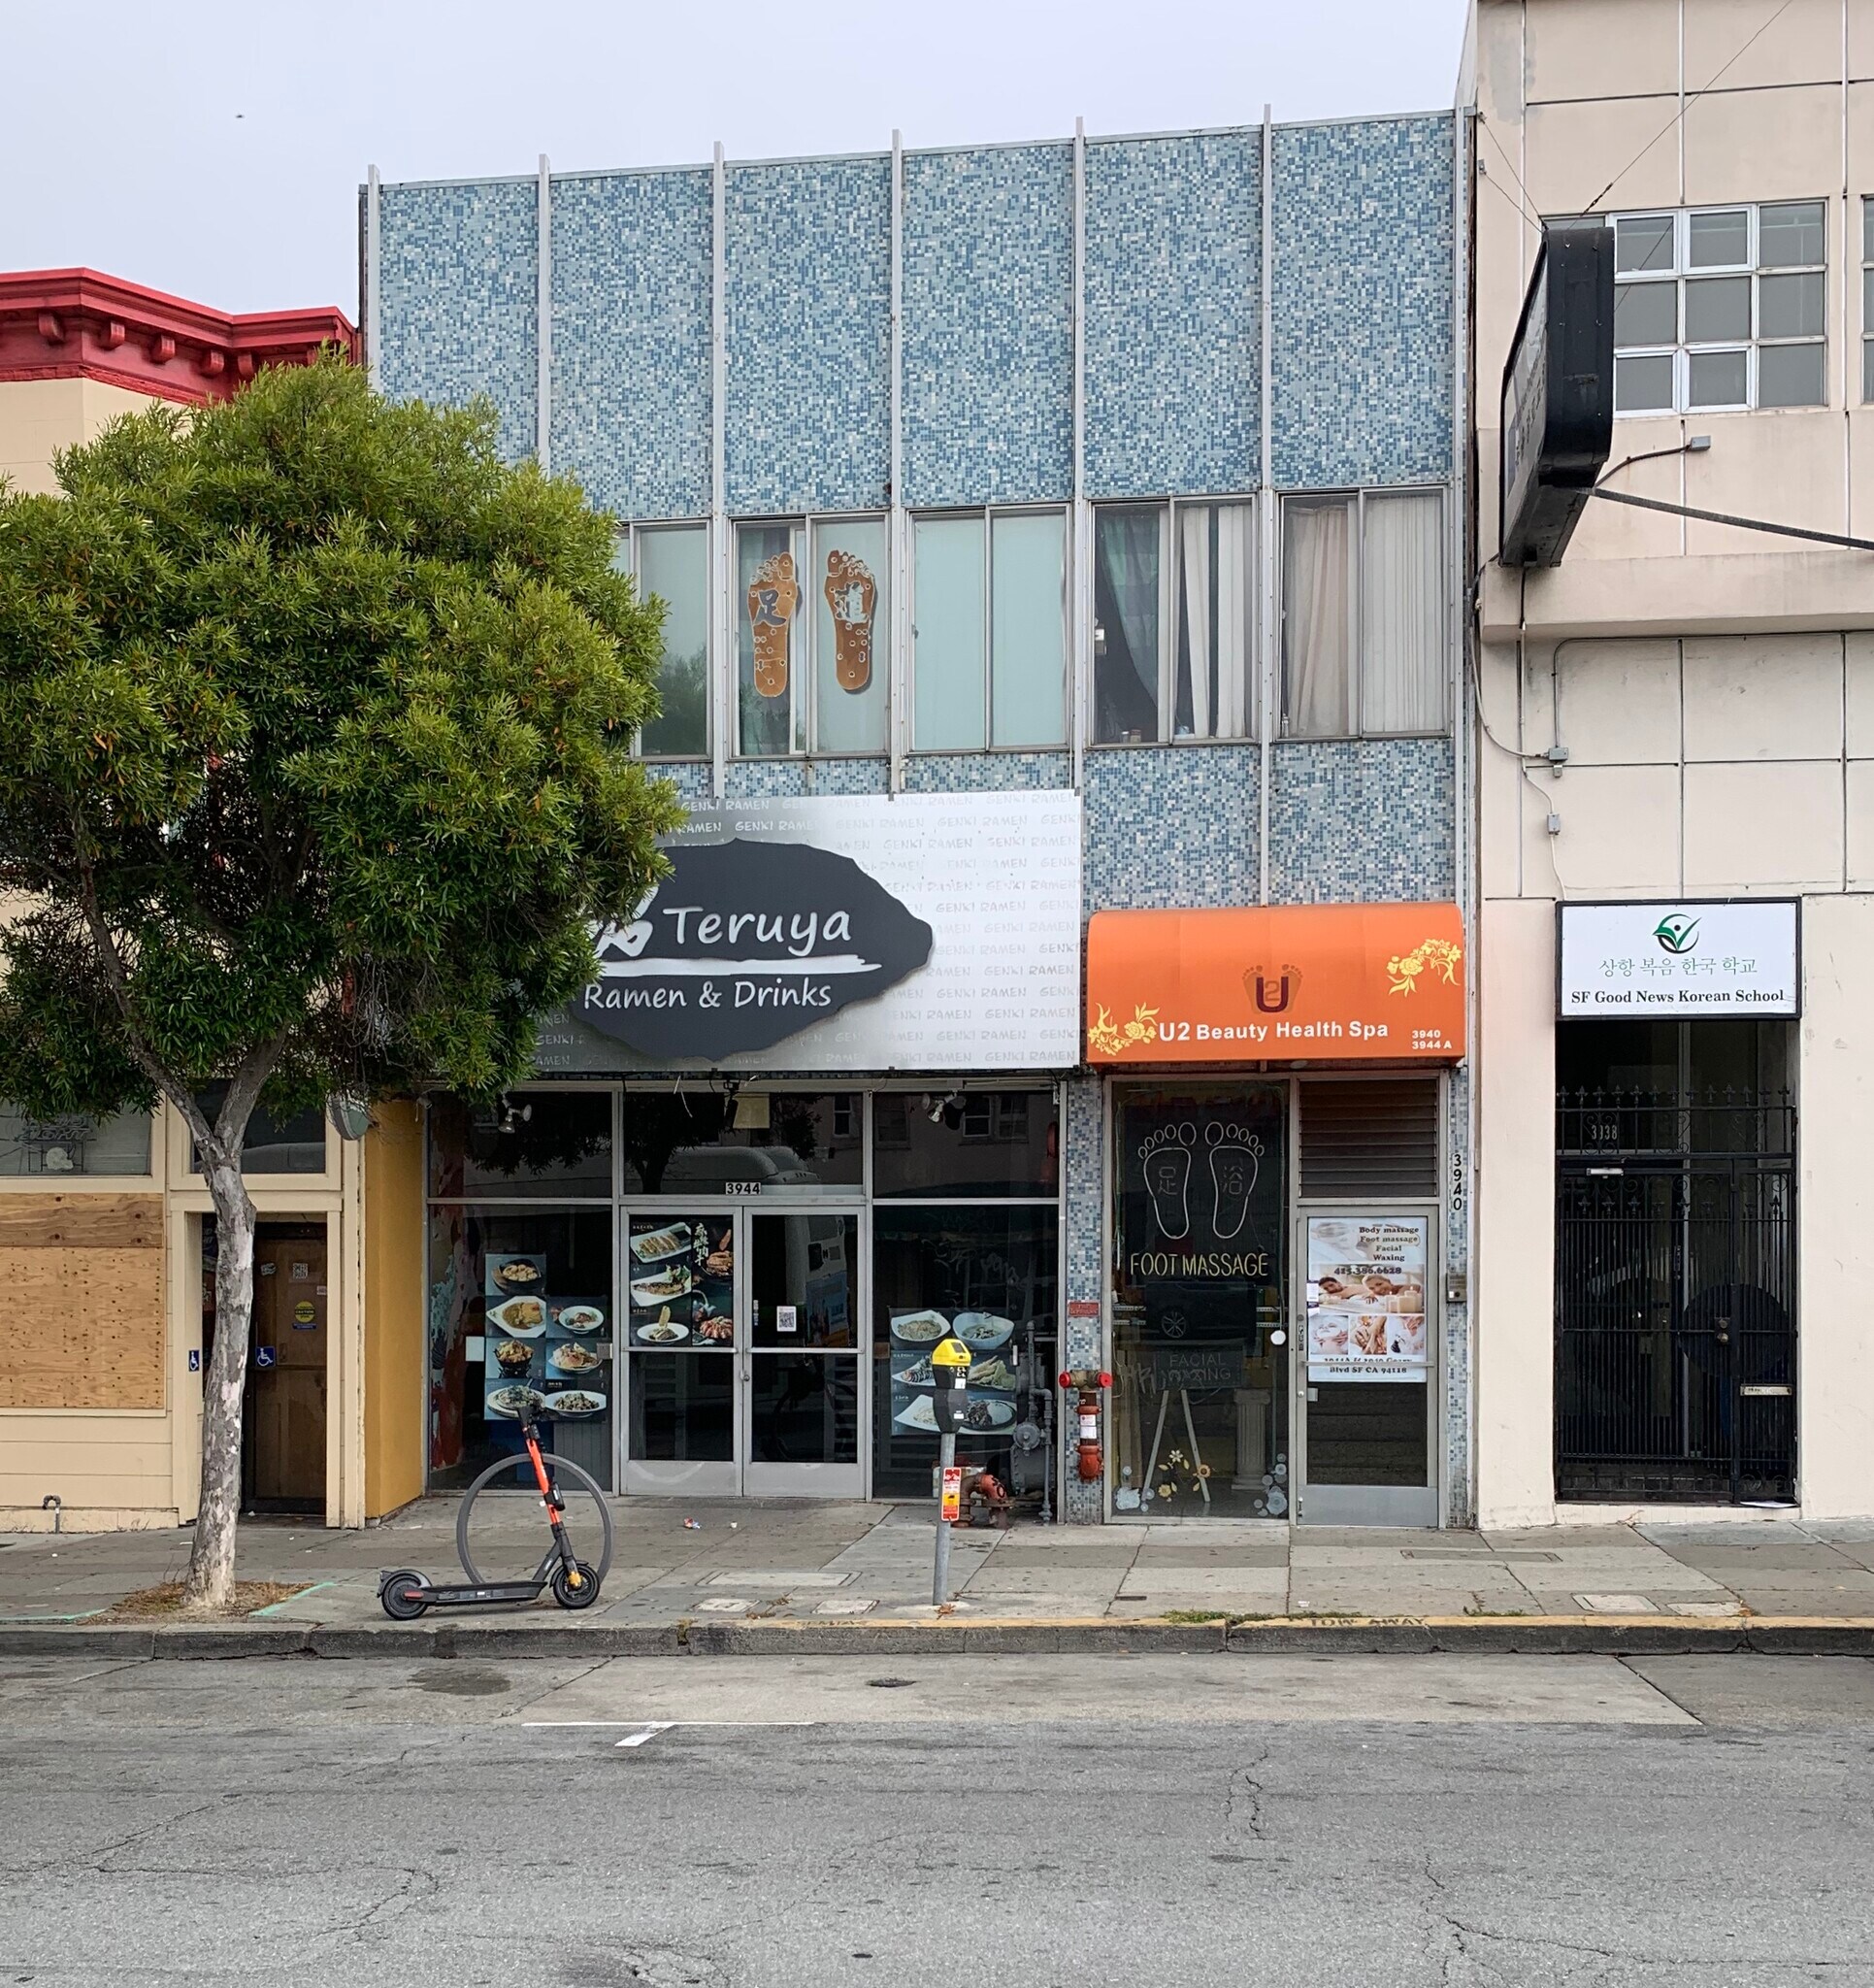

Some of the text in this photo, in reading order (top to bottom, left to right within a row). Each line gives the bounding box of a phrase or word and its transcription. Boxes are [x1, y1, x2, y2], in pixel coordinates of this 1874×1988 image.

[681, 800, 719, 812] GENKI
[725, 800, 770, 811] RAMEN
[929, 795, 972, 807] RAMEN
[986, 793, 1026, 805] GENKI
[735, 820, 773, 832] GENKI
[880, 817, 924, 828] RAMEN
[937, 816, 976, 827] GENKI
[982, 815, 1027, 826] RAMEN
[883, 839, 923, 850] GENKI
[928, 838, 972, 849] RAMEN
[1031, 836, 1075, 847] RAMEN
[1031, 878, 1075, 890] RAMEN
[936, 902, 974, 912] GENKI
[980, 901, 1026, 912] RAMEN
[1039, 900, 1078, 911] GENKI
[663, 906, 851, 957] Teruya
[984, 922, 1024, 934] GENKI
[1029, 921, 1074, 932] RAMEN
[980, 944, 1026, 955] RAMEN
[1038, 943, 1078, 953] GENKI
[983, 965, 1024, 977] GENKI
[1029, 964, 1074, 976] RAMEN
[1599, 958, 1635, 977] 상항
[1681, 957, 1717, 976] 한국
[1722, 955, 1758, 976] 학교
[584, 977, 832, 1010] Ramen & Drinks
[937, 987, 976, 999] GENKI
[980, 986, 1026, 998] RAMEN
[1571, 989, 1785, 1003] SF Good News Korean School
[927, 1009, 971, 1019] RAMEN
[985, 1008, 1024, 1018] GENKI
[1030, 1007, 1075, 1018] RAMEN
[937, 1031, 976, 1042] GENKI
[980, 1029, 1026, 1041] RAMEN
[1039, 1028, 1079, 1040] GENKI
[1159, 1020, 1389, 1043] U2 Beauty Health Spa
[1412, 1029, 1441, 1039] 3940
[1412, 1041, 1452, 1049] 3944 A
[927, 1051, 971, 1063] RAMEN
[985, 1051, 1025, 1063] GENKI
[1029, 1050, 1075, 1062] RAMEN
[1453, 1153, 1463, 1210] 3940
[727, 1182, 761, 1195] 3944
[1359, 1226, 1381, 1235] Body
[1130, 1252, 1268, 1276] FOOT MASSAGE
[1169, 1352, 1227, 1368] FACIAL
[1309, 1617, 1425, 1627] TOW AWAY
